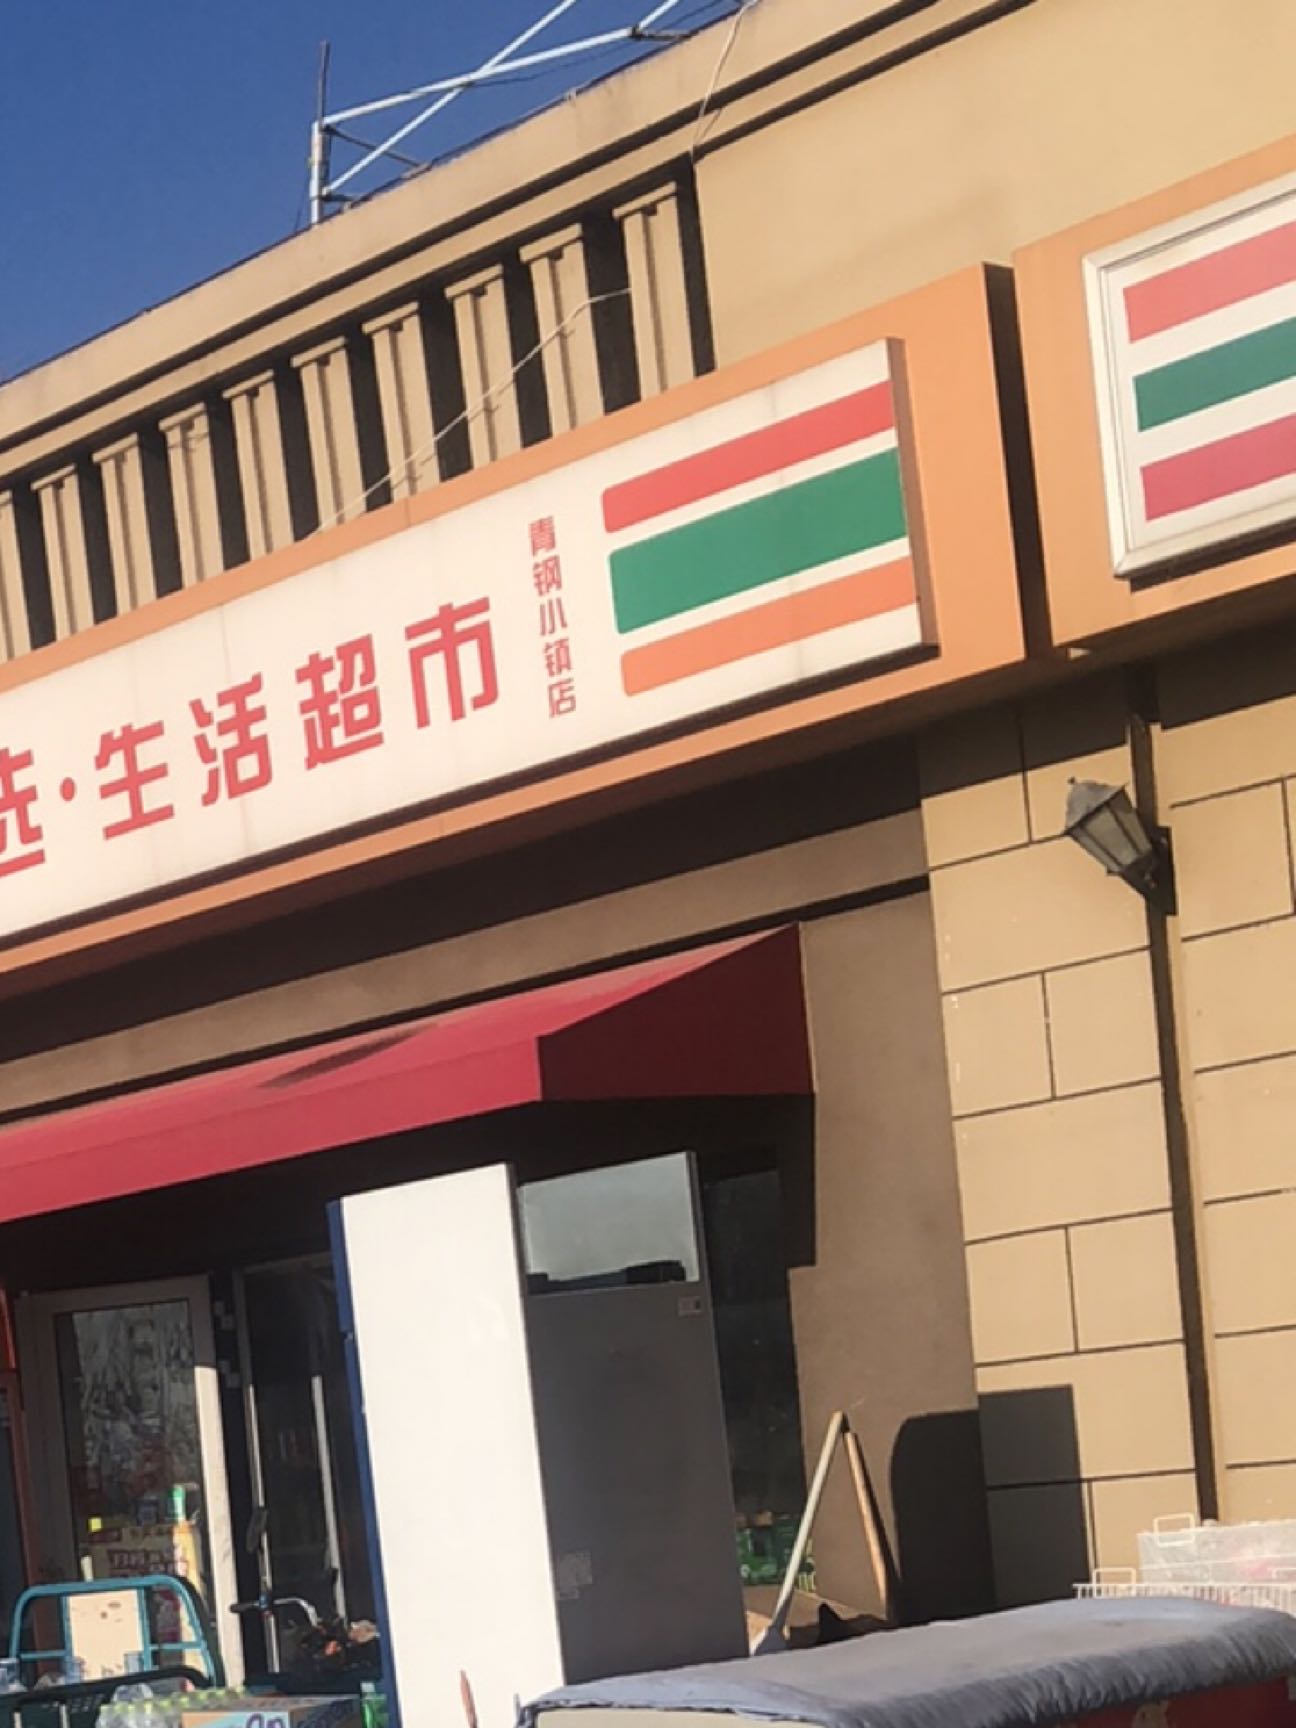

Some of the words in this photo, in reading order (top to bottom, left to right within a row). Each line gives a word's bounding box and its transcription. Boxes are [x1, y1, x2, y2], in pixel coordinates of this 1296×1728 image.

[527, 515, 577, 719] 青钢小镇店
